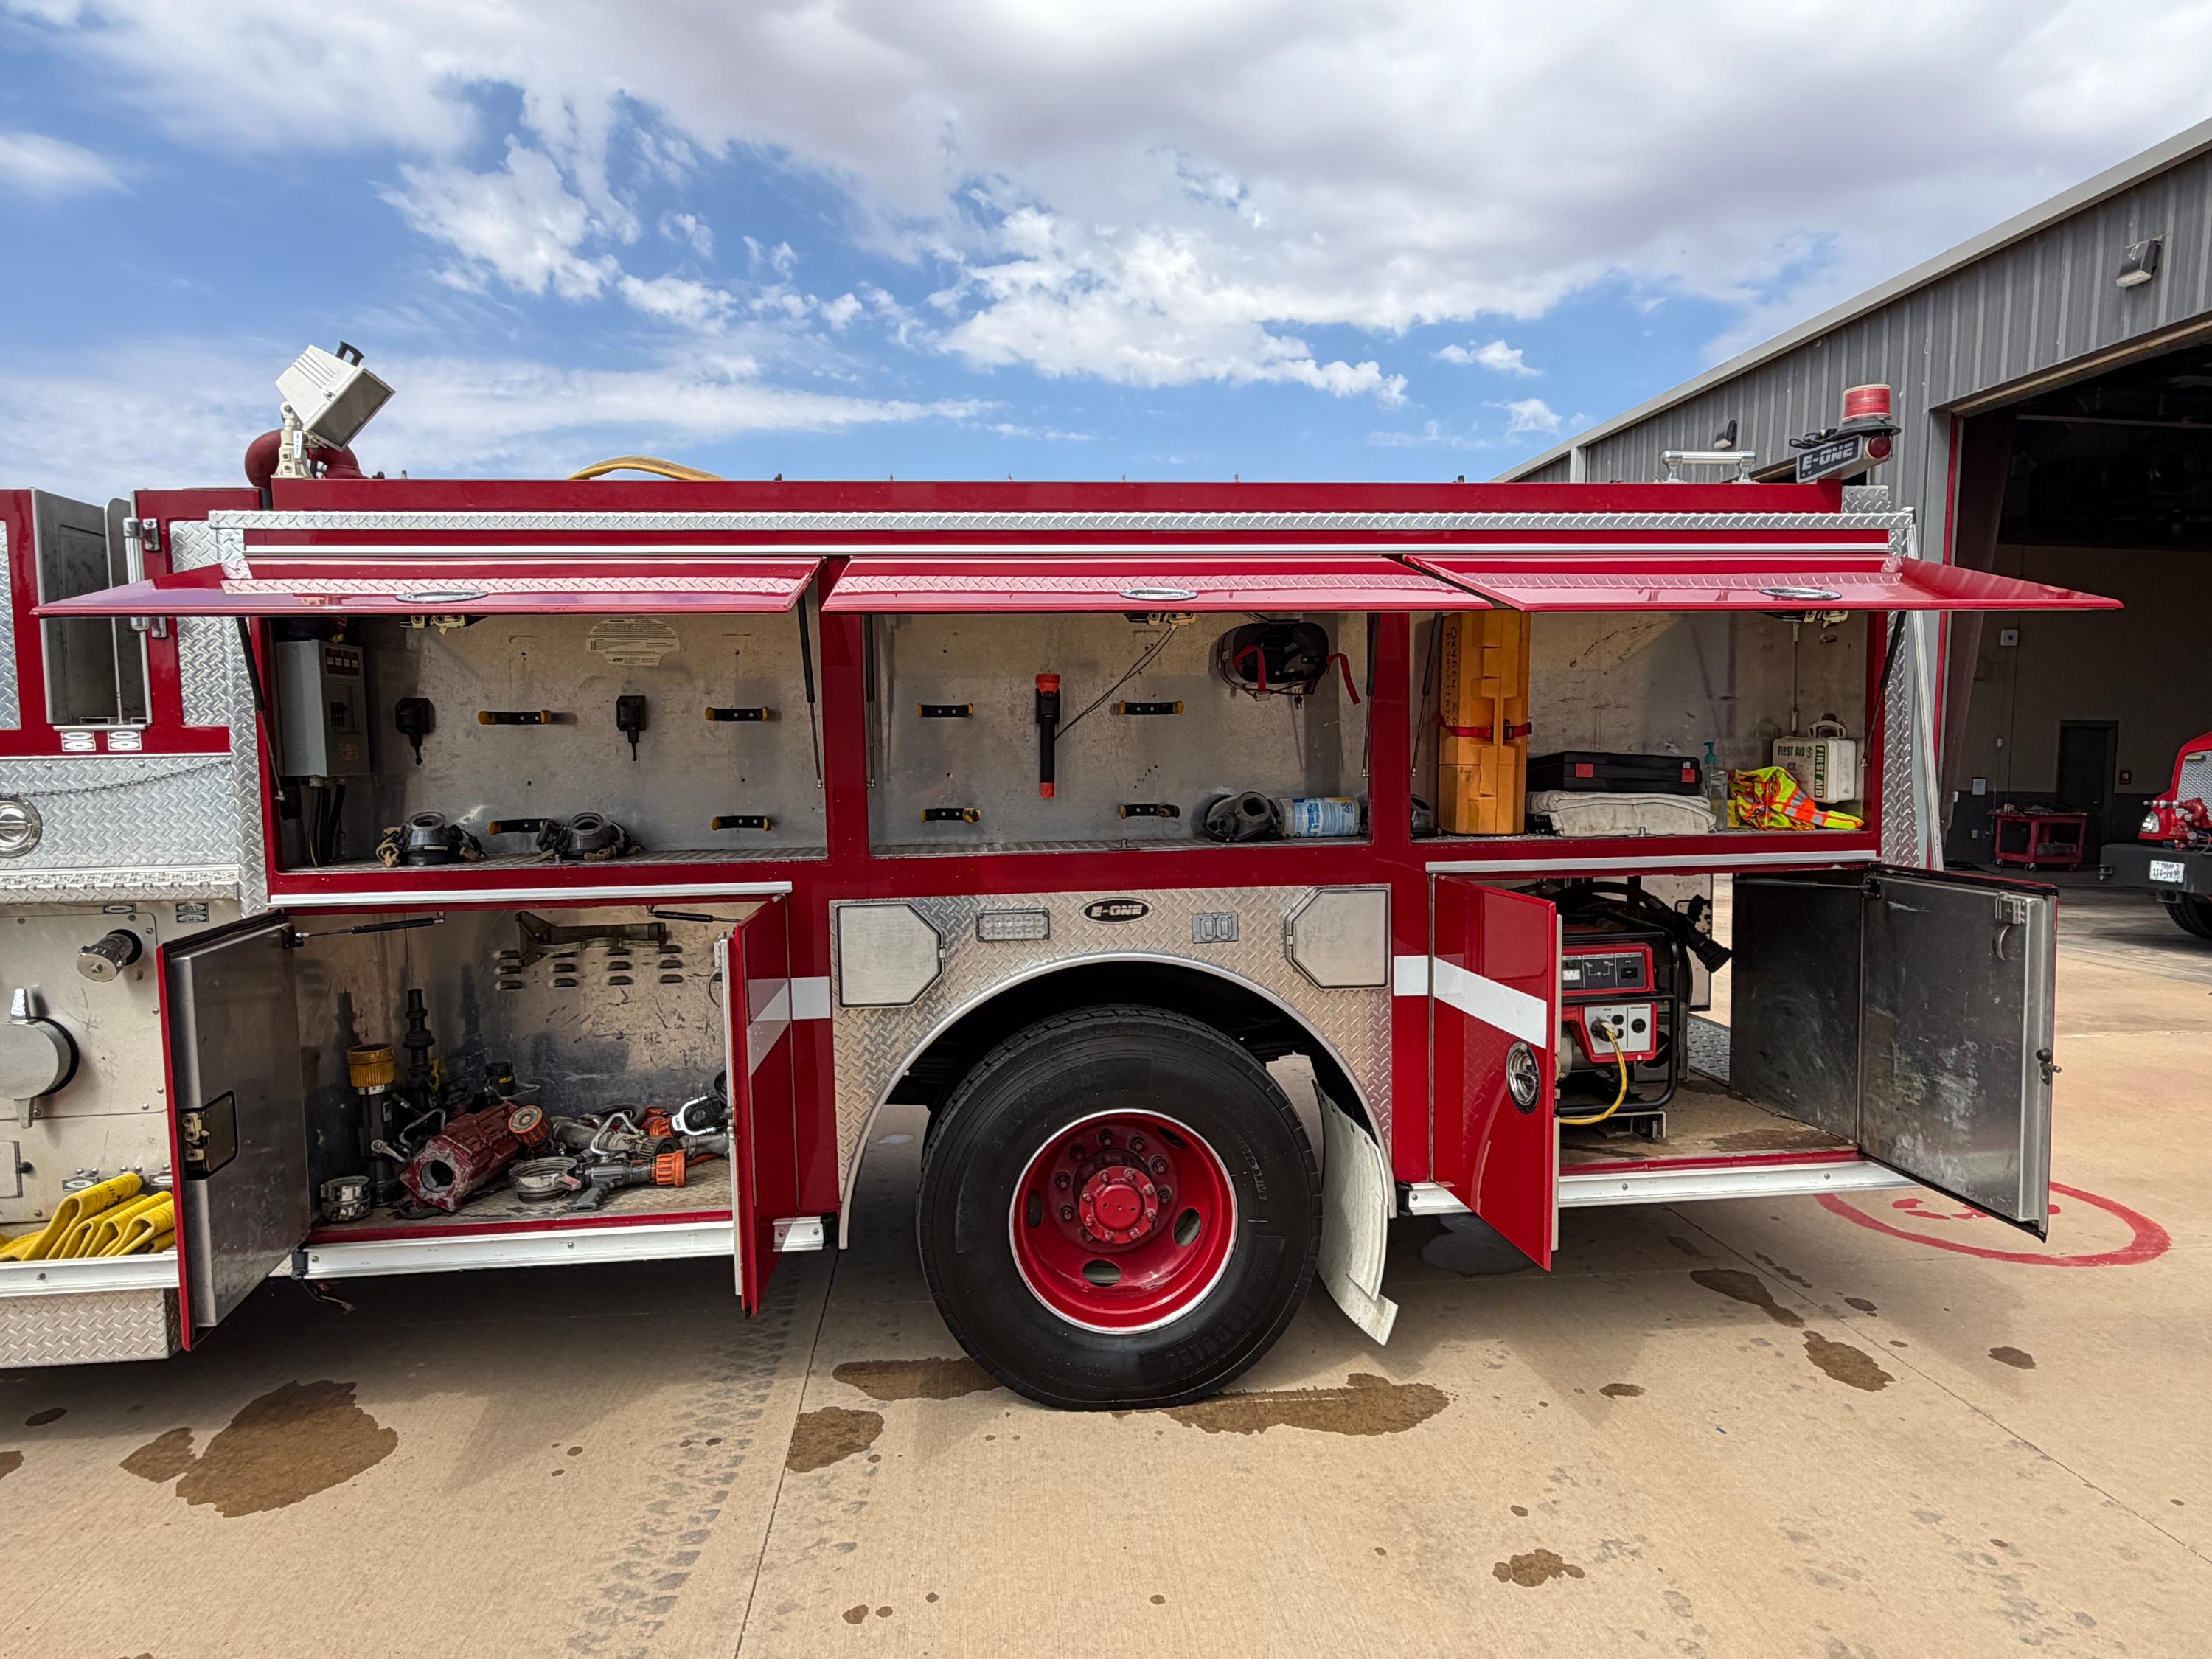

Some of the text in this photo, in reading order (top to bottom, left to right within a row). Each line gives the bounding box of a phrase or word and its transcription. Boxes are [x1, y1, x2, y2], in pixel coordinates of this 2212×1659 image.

[1801, 442, 1854, 471] E-ONE
[1450, 625, 1458, 689] OXYGEN
[1778, 746, 1805, 757] FIRST AID
[1815, 746, 1825, 798] FIRST AID
[1091, 904, 1143, 917] E-ONE
